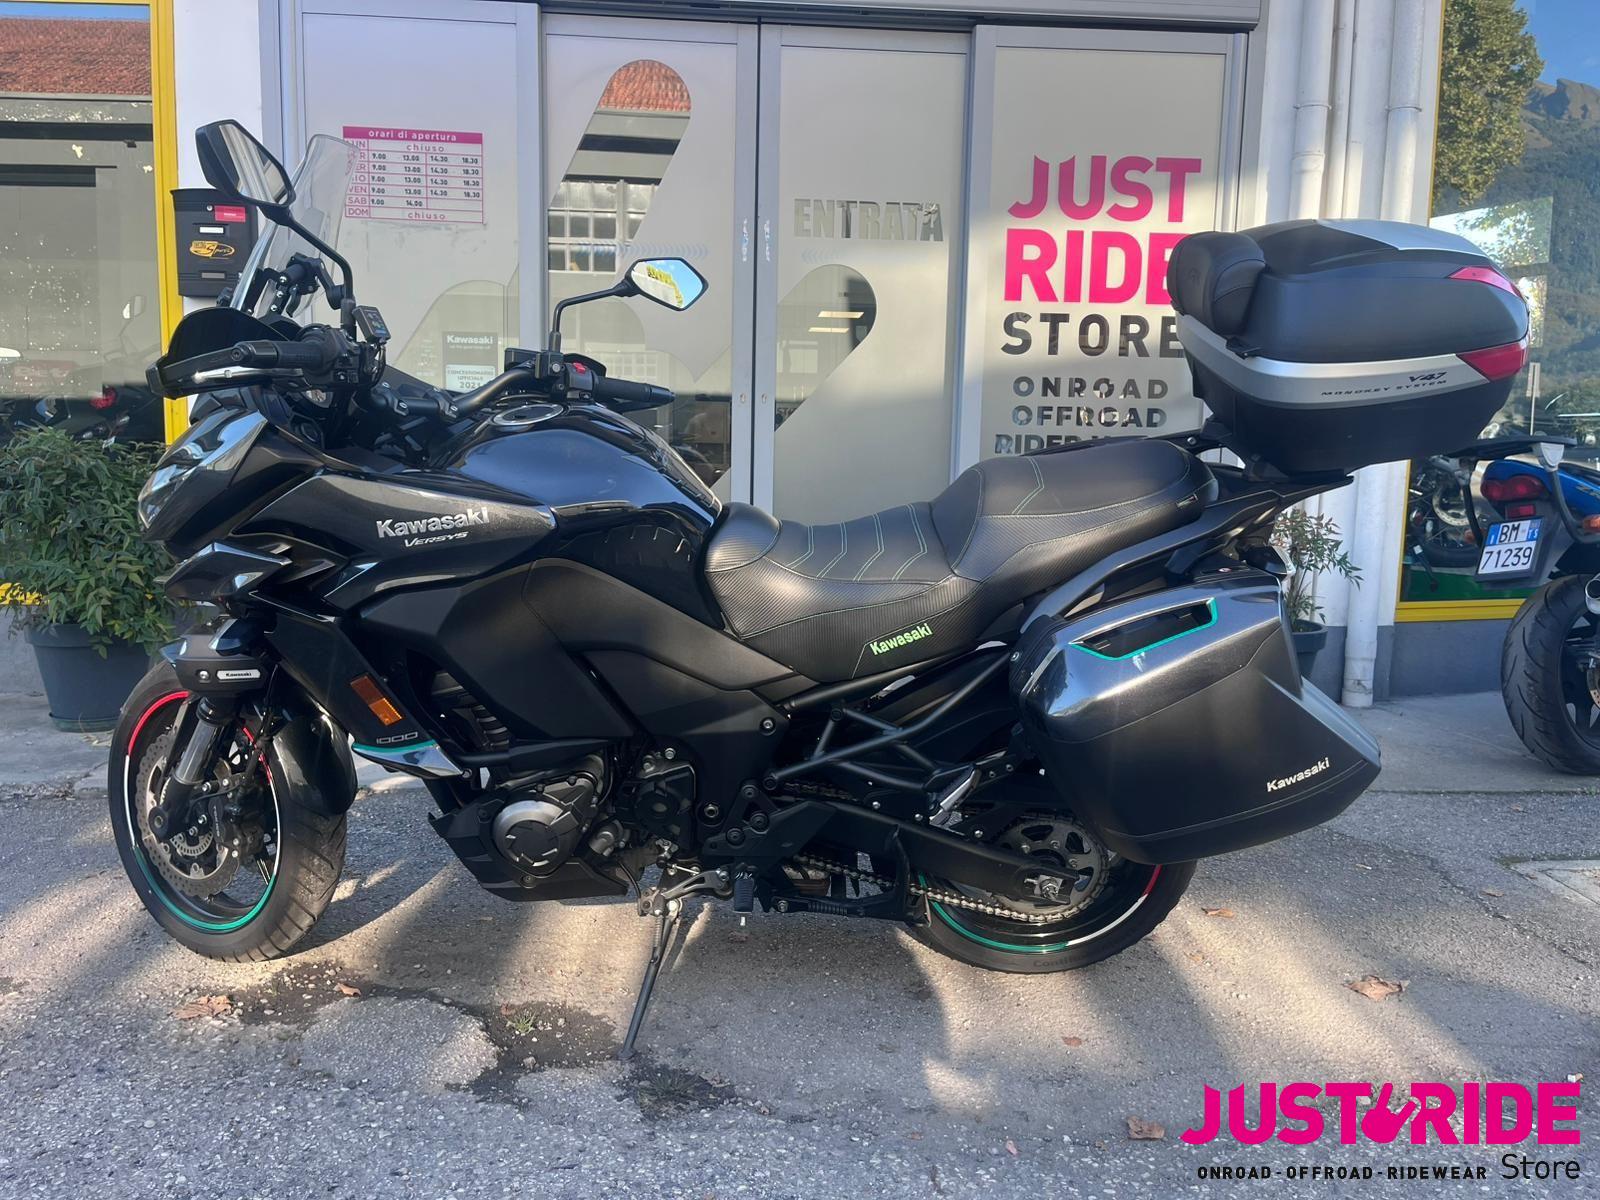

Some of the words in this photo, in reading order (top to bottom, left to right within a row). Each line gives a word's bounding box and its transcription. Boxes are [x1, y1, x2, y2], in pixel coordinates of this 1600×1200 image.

[368, 130, 395, 139] orari
[398, 130, 408, 139] di
[411, 132, 457, 142] apertura
[406, 143, 445, 152] chiuso
[430, 155, 449, 163] 14.30
[372, 164, 387, 172] 9.00
[462, 168, 479, 176] 18.30
[371, 175, 386, 183] 9.00
[430, 178, 449, 186] 14.30
[1007, 154, 1202, 223] JUST
[430, 189, 448, 197] 14.30
[348, 197, 367, 205] SAB
[405, 199, 423, 207] 14.00
[349, 207, 369, 216] DOM
[407, 210, 446, 220] chiuso
[793, 198, 944, 242] ENTRATA
[446, 334, 494, 345] Kawasaki
[1000, 311, 1185, 359] STORE
[1012, 375, 1169, 400] ONROAD
[1321, 386, 1391, 396] MONOKEY
[1396, 380, 1448, 390] SYSTEM
[1011, 404, 1168, 428] OFFROAD
[376, 506, 490, 539] Kawasaki
[404, 531, 469, 548] VERSYS
[1499, 523, 1520, 543] BM
[1481, 546, 1533, 570] 71239
[869, 622, 934, 656] Kawasaki
[1266, 757, 1330, 793] Kawasaki
